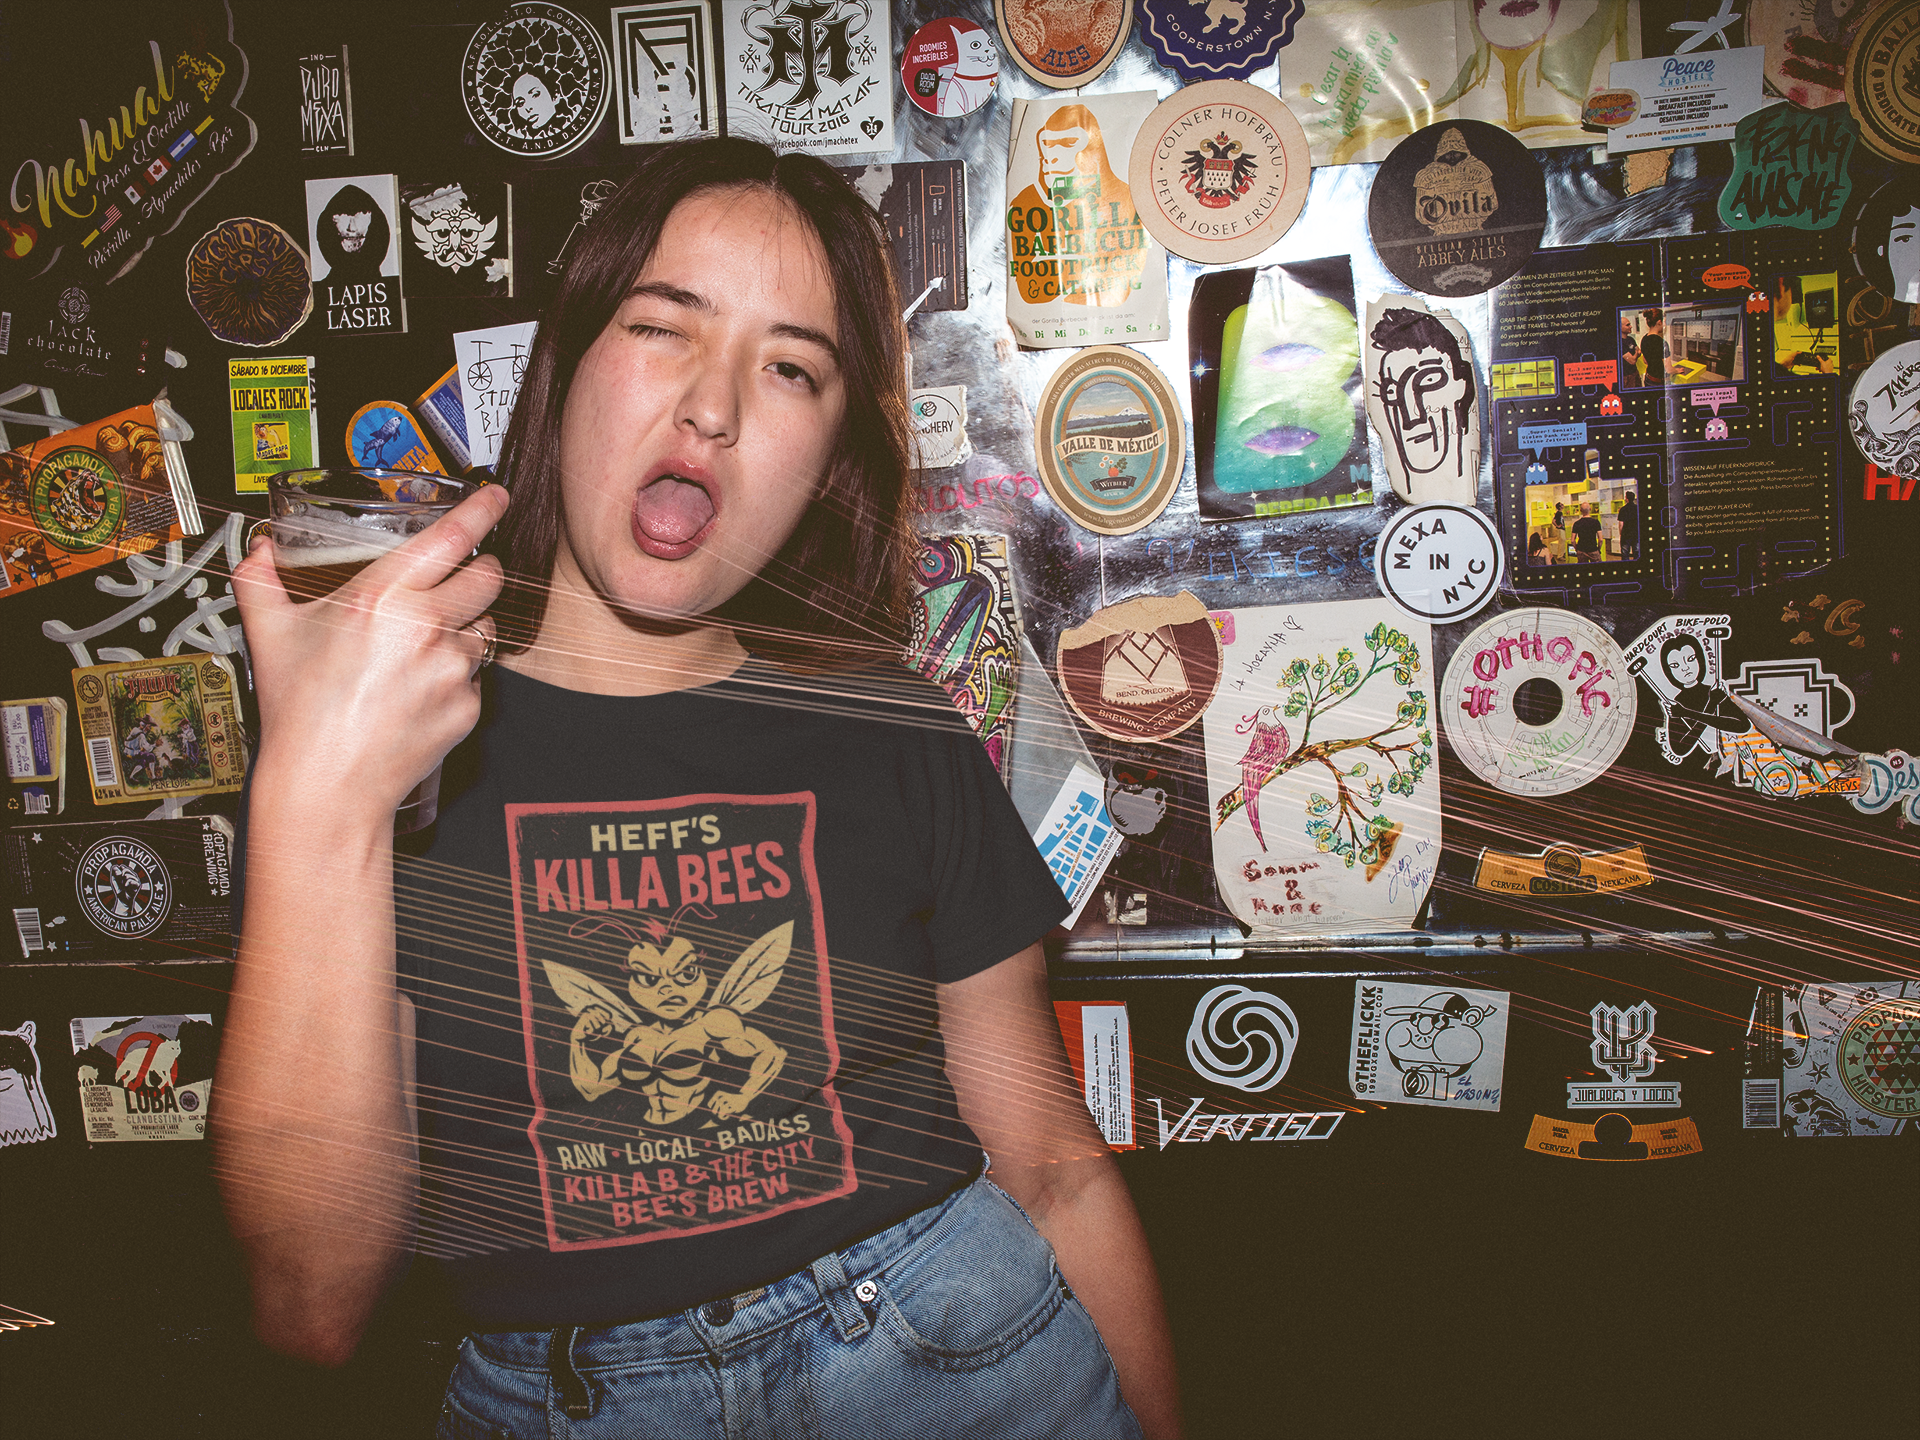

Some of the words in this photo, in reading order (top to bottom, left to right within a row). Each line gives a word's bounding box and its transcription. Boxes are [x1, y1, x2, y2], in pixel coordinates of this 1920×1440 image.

[1166, 14, 1262, 52] COOPERSTOWN
[912, 51, 949, 64] INCREÍBLES
[919, 41, 947, 52] ROOMIES
[1040, 44, 1091, 67] ALES
[1663, 58, 1715, 78] Peace
[1668, 73, 1704, 85] HOSTEL
[300, 65, 340, 106] PURO
[738, 82, 796, 120] TIRATE
[818, 76, 880, 119] MATAR
[1658, 102, 1686, 111] BREAKFAST
[1687, 99, 1711, 108] INCLUDED
[1659, 115, 1685, 123] DESAYUNO
[1686, 112, 1709, 120] INCLUIDO
[10, 40, 175, 228] Nahual
[301, 101, 346, 144] MEXA
[771, 116, 817, 135] TOUR
[818, 113, 850, 134] 2016
[1159, 109, 1212, 160] CÖLNER
[1222, 108, 1282, 166] HOFBRÄU
[1157, 179, 1186, 223] PETER
[1189, 220, 1238, 236] JOSEF
[1245, 185, 1279, 225] FRÜH
[1015, 229, 1152, 257] BARBECUE
[1418, 250, 1466, 268] ABBEY
[1470, 245, 1506, 261] ALES
[1028, 279, 1040, 298] &
[1043, 274, 1142, 296] CATERING
[1549, 271, 1576, 279] ZEITREISE
[328, 283, 388, 307] LAPIS
[326, 306, 393, 330] LÁSER
[1528, 314, 1555, 322] JOYSTICK
[1035, 331, 1045, 339] Di
[1055, 330, 1067, 338] Mi
[1104, 326, 1114, 335] Fr
[1126, 324, 1137, 333] Sa
[231, 363, 259, 376] SÁBADO
[261, 365, 268, 375] 16
[270, 364, 306, 375] DICIEMBRE
[233, 389, 277, 410] LOCALES
[279, 388, 307, 409] ROCK
[1062, 437, 1097, 454] VALLE
[1100, 439, 1114, 451] DE
[1117, 434, 1159, 453] MÉXICO
[82, 519, 114, 546] SUPER
[108, 495, 119, 514] IPA
[1393, 518, 1447, 570] MEXA
[1429, 553, 1449, 570] IN
[1442, 558, 1486, 605] NYC
[1624, 622, 1667, 663] HARDCOURT
[1676, 616, 1728, 627] BIKE-POLO
[1141, 686, 1175, 697] OREGON
[1098, 709, 1145, 733] BREWING
[1152, 699, 1197, 731] COMPANY
[590, 814, 722, 852] HEFF'S
[202, 833, 218, 885] BREWING
[534, 855, 670, 912] KILLA
[677, 841, 792, 907] BEES
[1490, 880, 1526, 891] CERVEZA
[1600, 874, 1642, 889] MEXICANA
[86, 896, 128, 932] AMERICAN
[130, 913, 155, 931] PALE
[151, 893, 164, 914] ALE
[1355, 985, 1377, 1094] @THEFLICKK
[123, 1086, 179, 1114] LOBA
[1643, 1088, 1675, 1102] LOCOS
[1852, 1074, 1917, 1111] HIPSTER
[126, 1115, 183, 1125] CLANDESTINA
[1147, 1097, 1346, 1151] VERTIGO
[557, 1143, 609, 1170] RAW
[625, 1136, 699, 1165] LOCAL
[717, 1113, 811, 1151] BADASS
[1538, 1141, 1575, 1155] CERVEZA
[1650, 1143, 1693, 1156] MEXICANA
[563, 1171, 647, 1203] KILLA
[657, 1167, 679, 1192] B
[685, 1165, 710, 1185] &
[708, 1150, 754, 1183] THE
[761, 1137, 816, 1173] CITY
[611, 1190, 697, 1228] BEE'S
[706, 1173, 790, 1214] BREW
